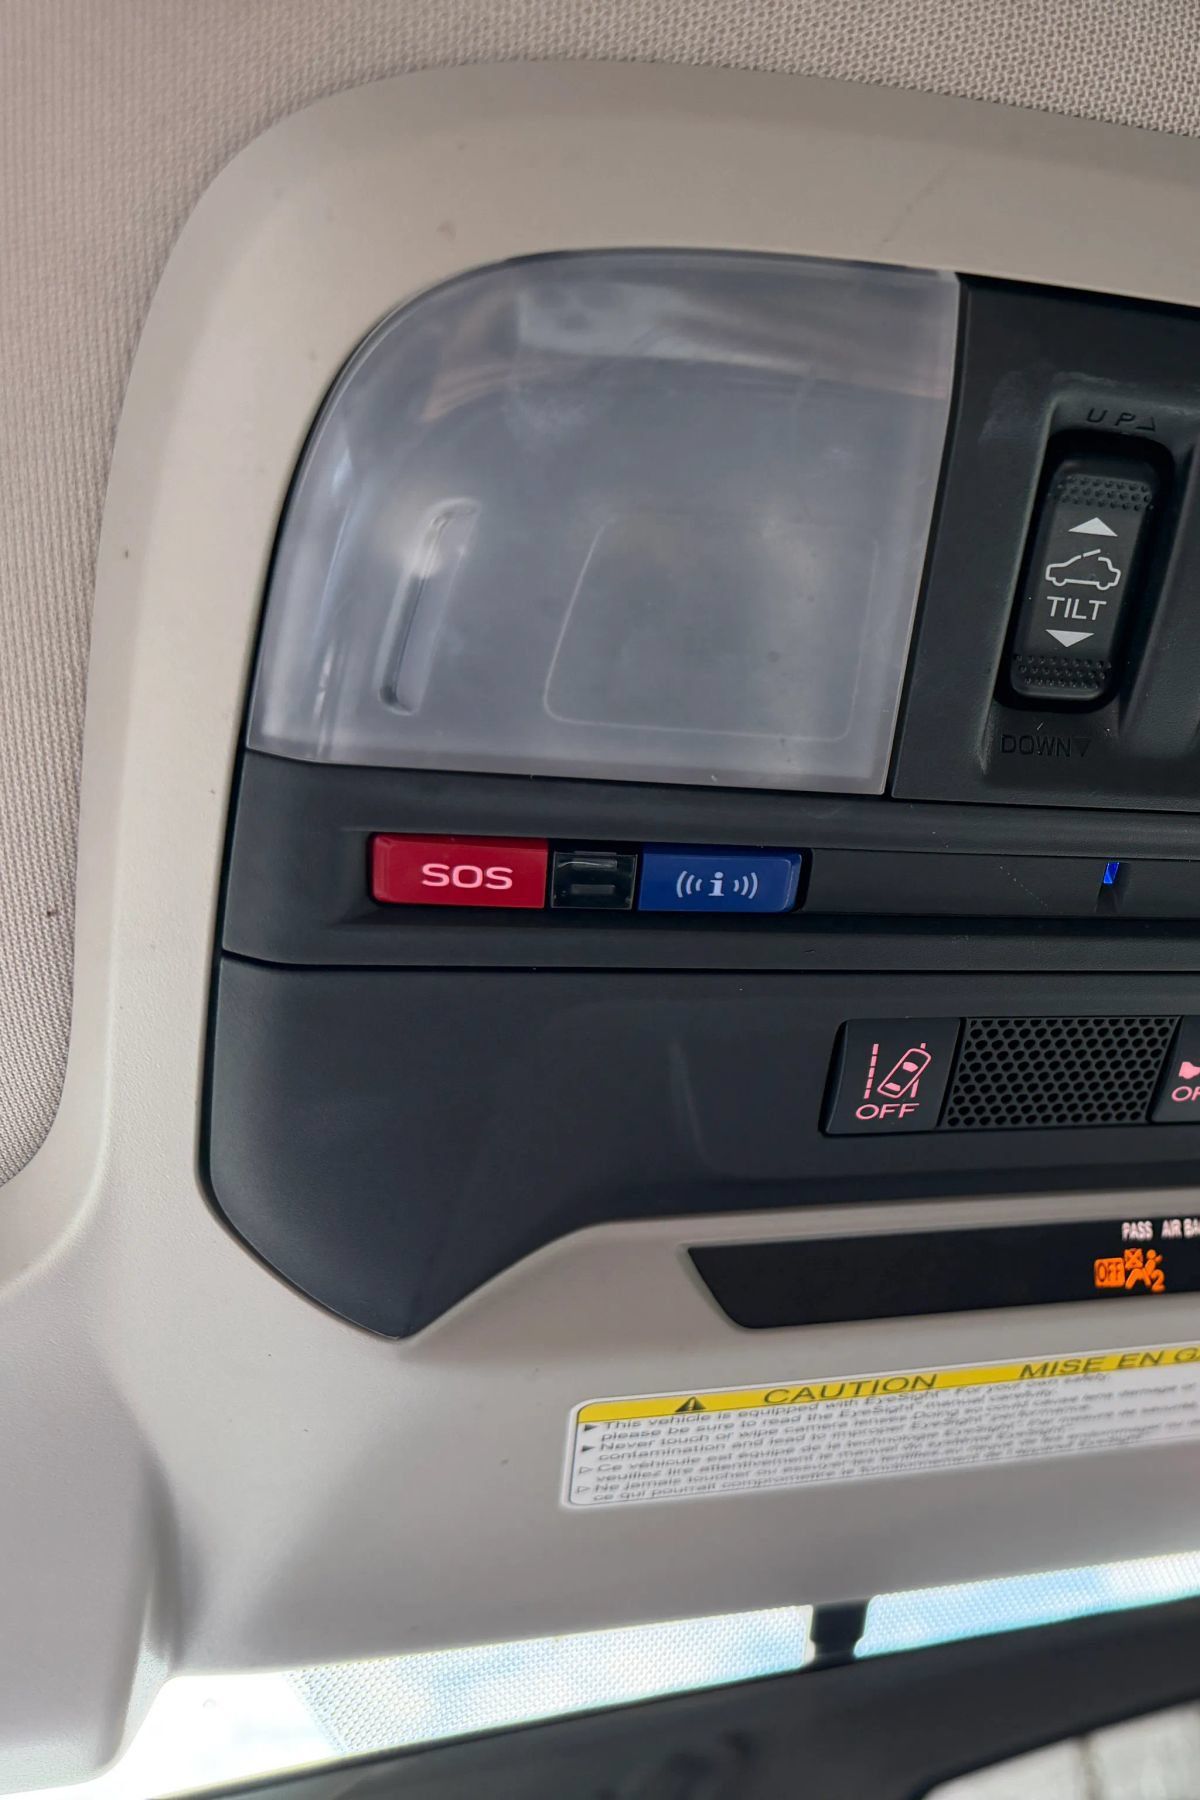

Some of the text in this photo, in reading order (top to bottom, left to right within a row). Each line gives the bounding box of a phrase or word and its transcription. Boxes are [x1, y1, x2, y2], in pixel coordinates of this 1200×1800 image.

[1046, 596, 1107, 621] TILT
[1000, 734, 1071, 759] DOWN
[421, 863, 514, 890] SOS
[855, 1102, 920, 1121] OFF
[1122, 1221, 1154, 1241] PASS
[1160, 1219, 1183, 1239] AIR
[1097, 1261, 1122, 1283] OFF
[1017, 1355, 1106, 1379] MISE
[1116, 1349, 1166, 1370] EN
[763, 1373, 939, 1405] CAUTION
[600, 1427, 661, 1442] please
[669, 1425, 690, 1434] be
[697, 1422, 735, 1431] sure
[763, 1414, 801, 1424] read
[808, 1410, 833, 1420] the
[603, 1418, 641, 1429] This
[648, 1412, 710, 1425] vehicle
[737, 1402, 819, 1419] equipped
[825, 1398, 855, 1408] with
[598, 1441, 727, 1461] contamination
[732, 1437, 765, 1448] and
[600, 1438, 655, 1451] Never
[661, 1433, 709, 1445] touch
[738, 1427, 779, 1439] wipe
